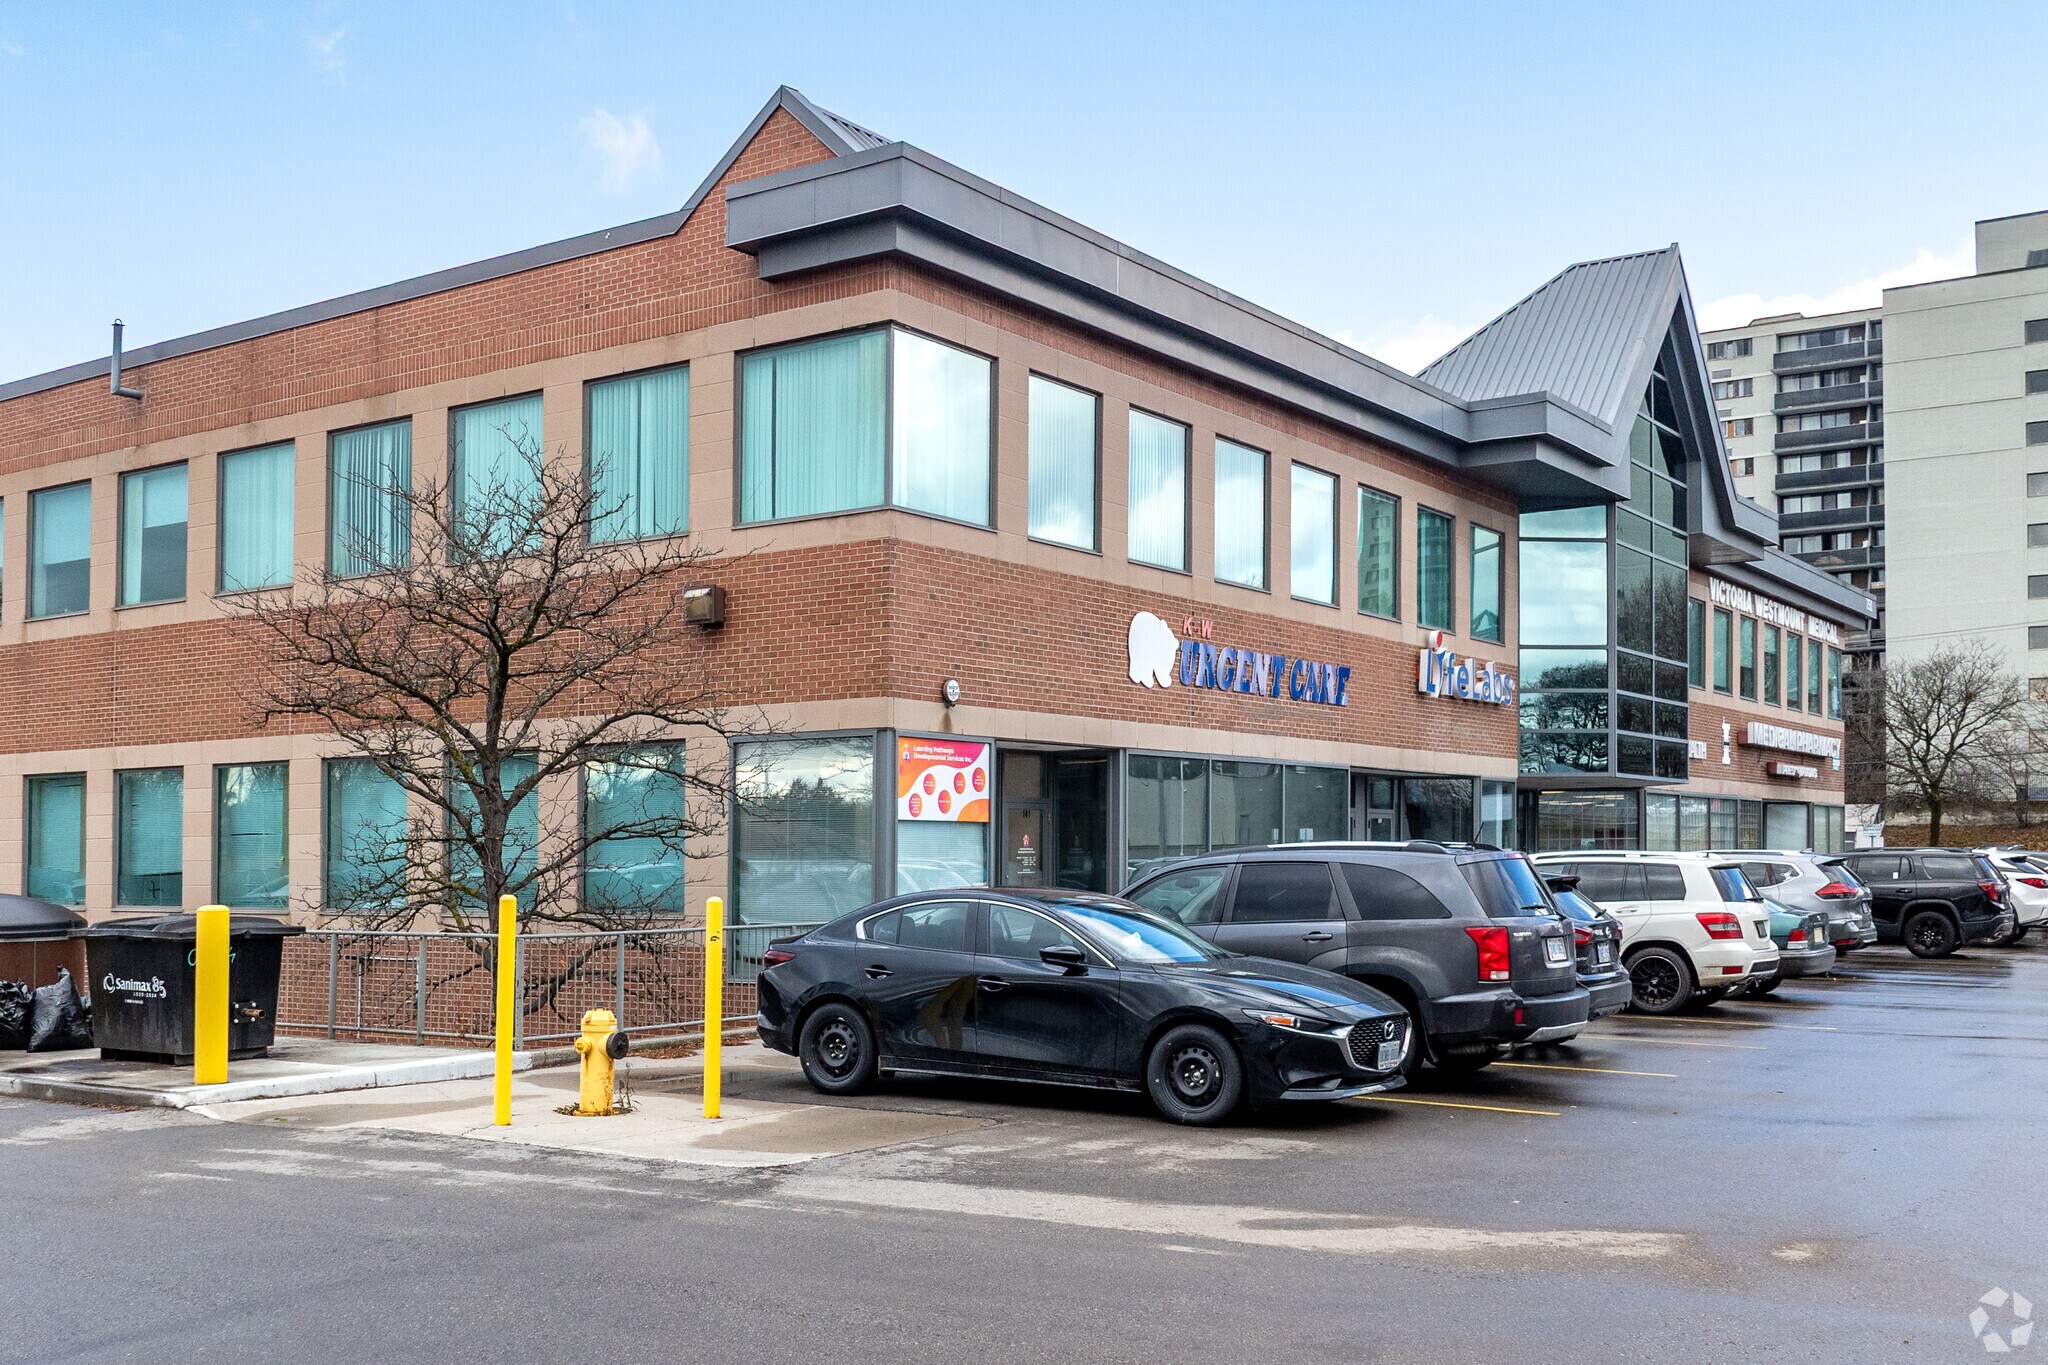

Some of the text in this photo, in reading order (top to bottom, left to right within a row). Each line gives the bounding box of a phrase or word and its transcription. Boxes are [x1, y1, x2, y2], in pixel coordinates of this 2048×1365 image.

[1709, 576, 1839, 645] VICTORIA WESTMOUNT MEDICAL
[1180, 640, 1350, 706] URGENT CARE
[1419, 630, 1514, 705] LifeLabs
[1753, 721, 1796, 751] MEDICAL
[914, 745, 954, 755] Learning Pathways
[914, 753, 946, 761] Developmental
[1688, 739, 1707, 759] ALTH
[116, 978, 151, 992] Sanimax
